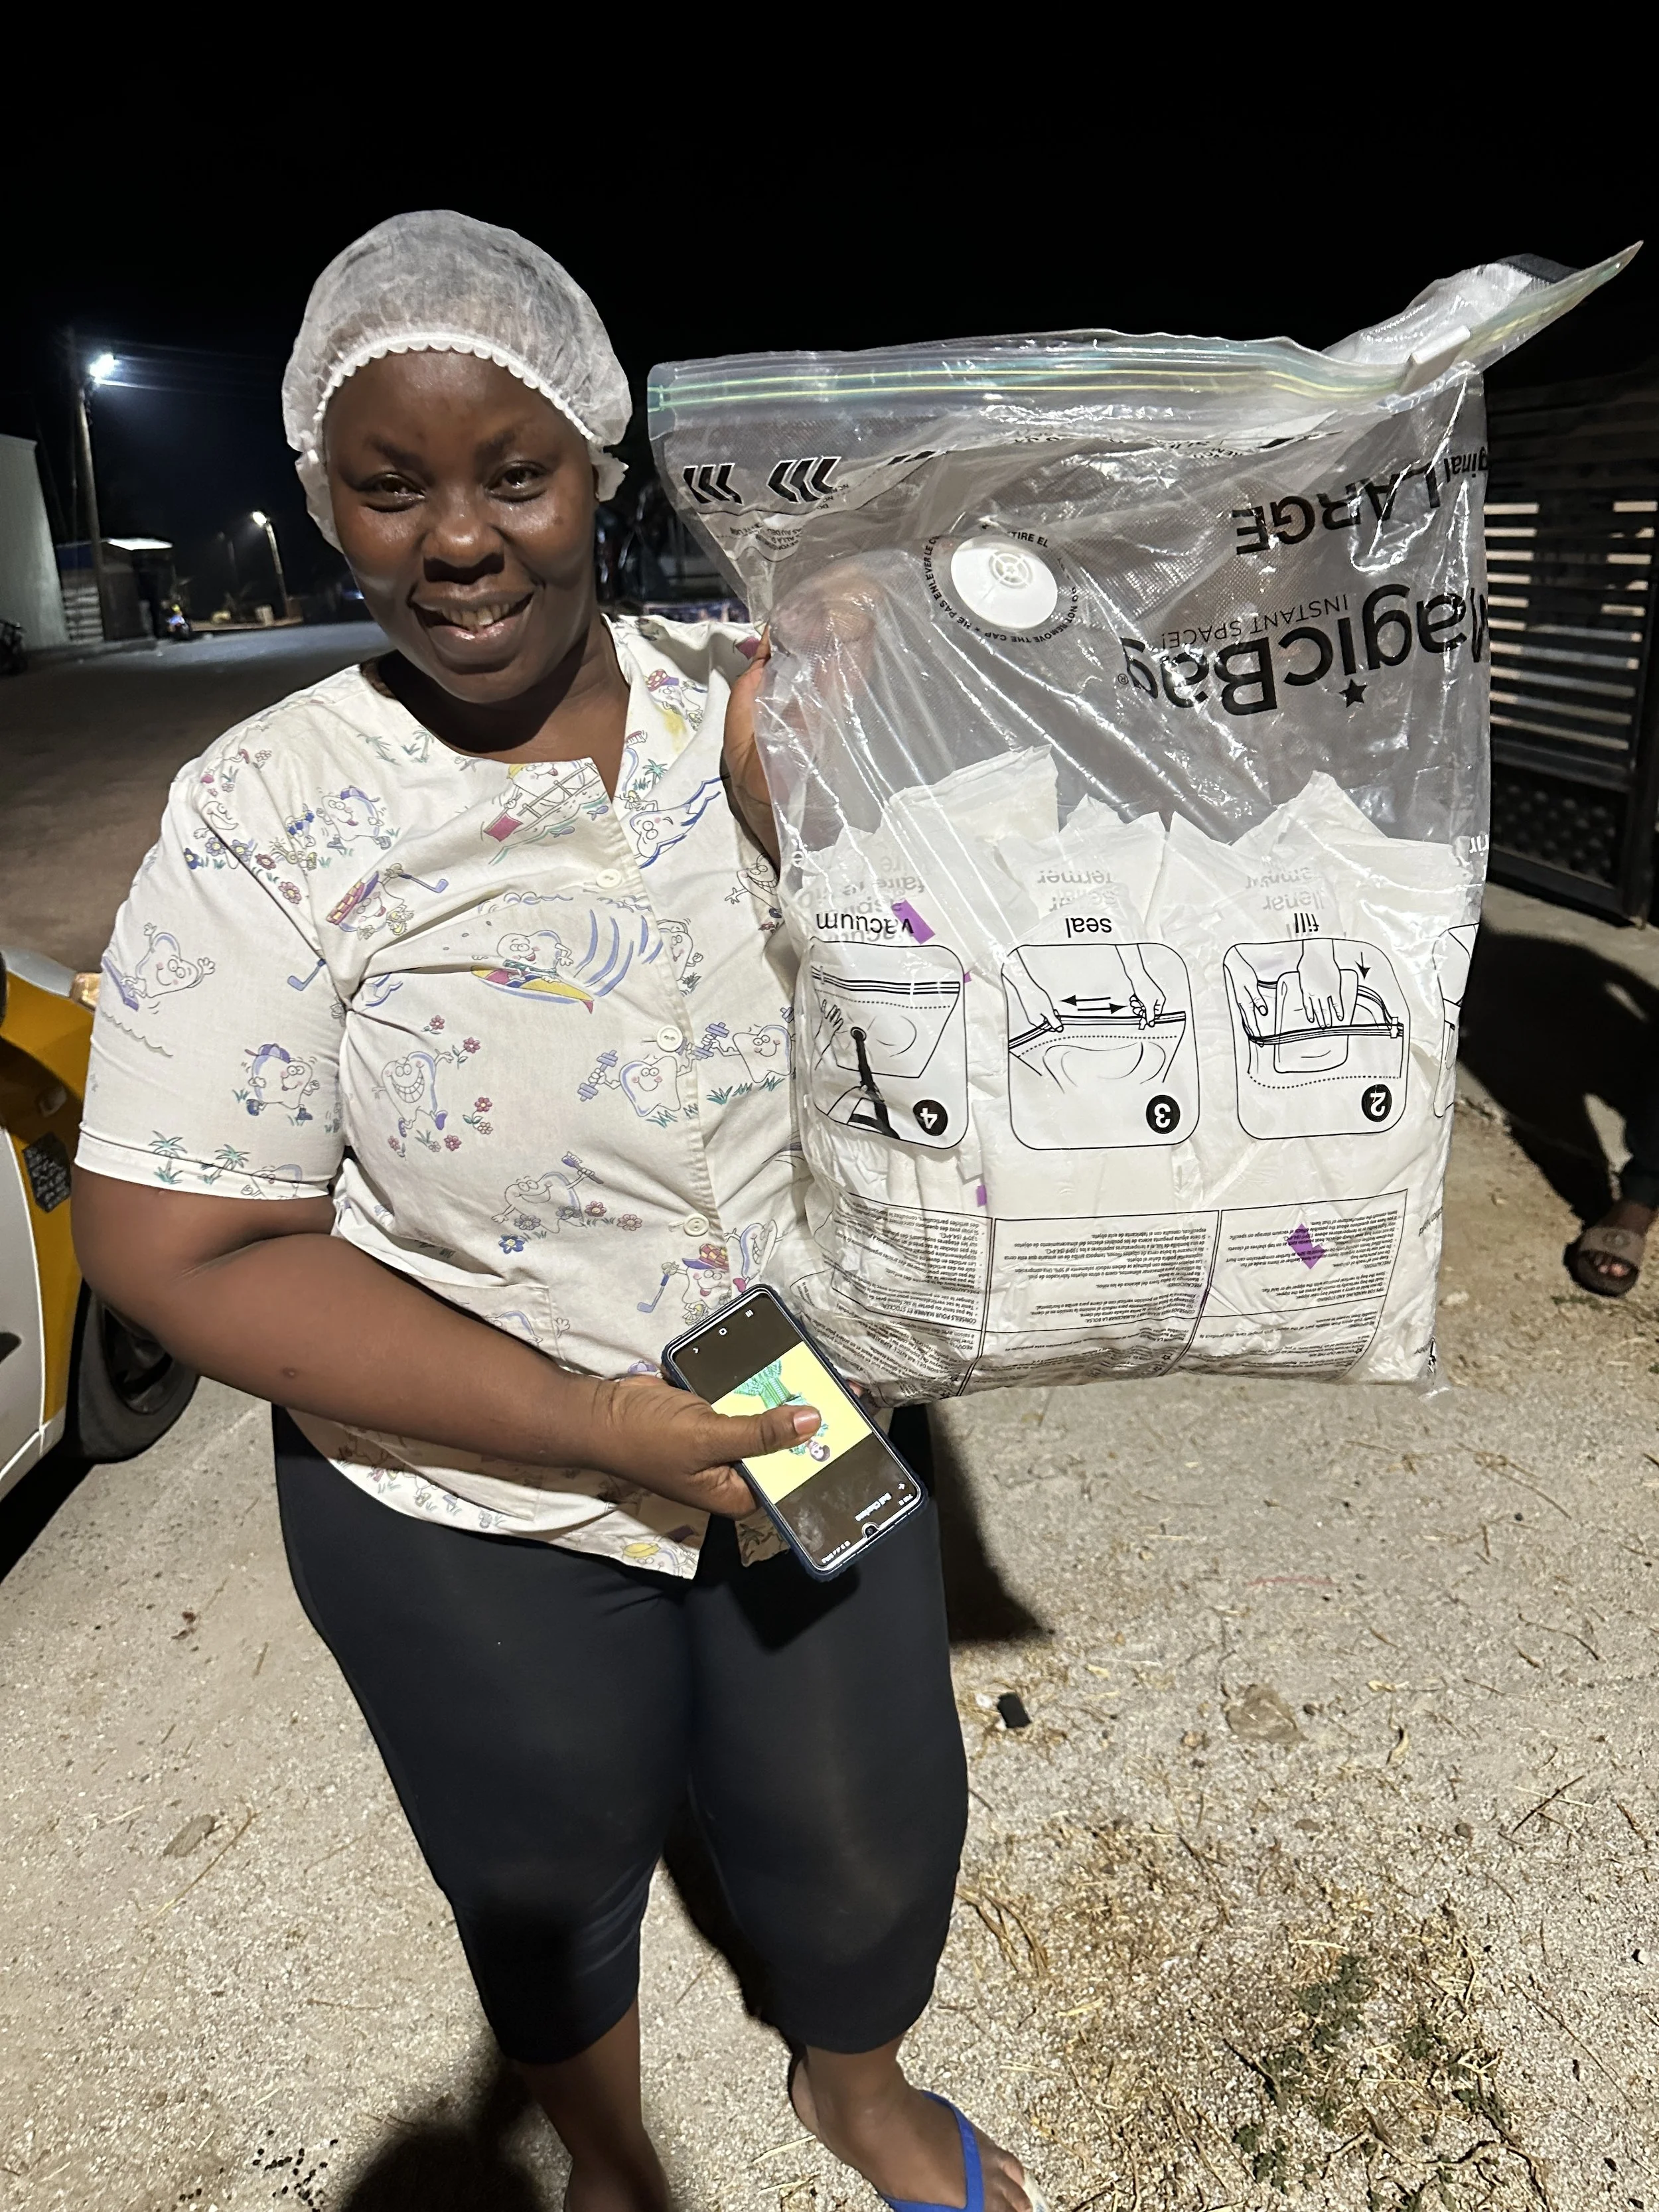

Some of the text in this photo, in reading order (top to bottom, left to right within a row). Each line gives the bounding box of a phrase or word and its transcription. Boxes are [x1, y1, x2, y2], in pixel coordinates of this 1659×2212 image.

[1232, 462, 1441, 555] LARGE
[924, 545, 933, 556] LE
[1037, 536, 1048, 548] EL
[924, 556, 942, 600] ENLEVER
[939, 599, 957, 619] PAS
[1064, 605, 1078, 624] NOT
[1161, 594, 1348, 649] INSTANT SPACE!
[984, 632, 1007, 641] CAP
[1034, 622, 1068, 643] REMOVE
[816, 913, 914, 934] vacuum
[1066, 917, 1112, 938] seal
[1295, 913, 1319, 933] fill
[1370, 1092, 1386, 1116] 2
[920, 1108, 938, 1129] 4
[1154, 1103, 1171, 1128] 3
